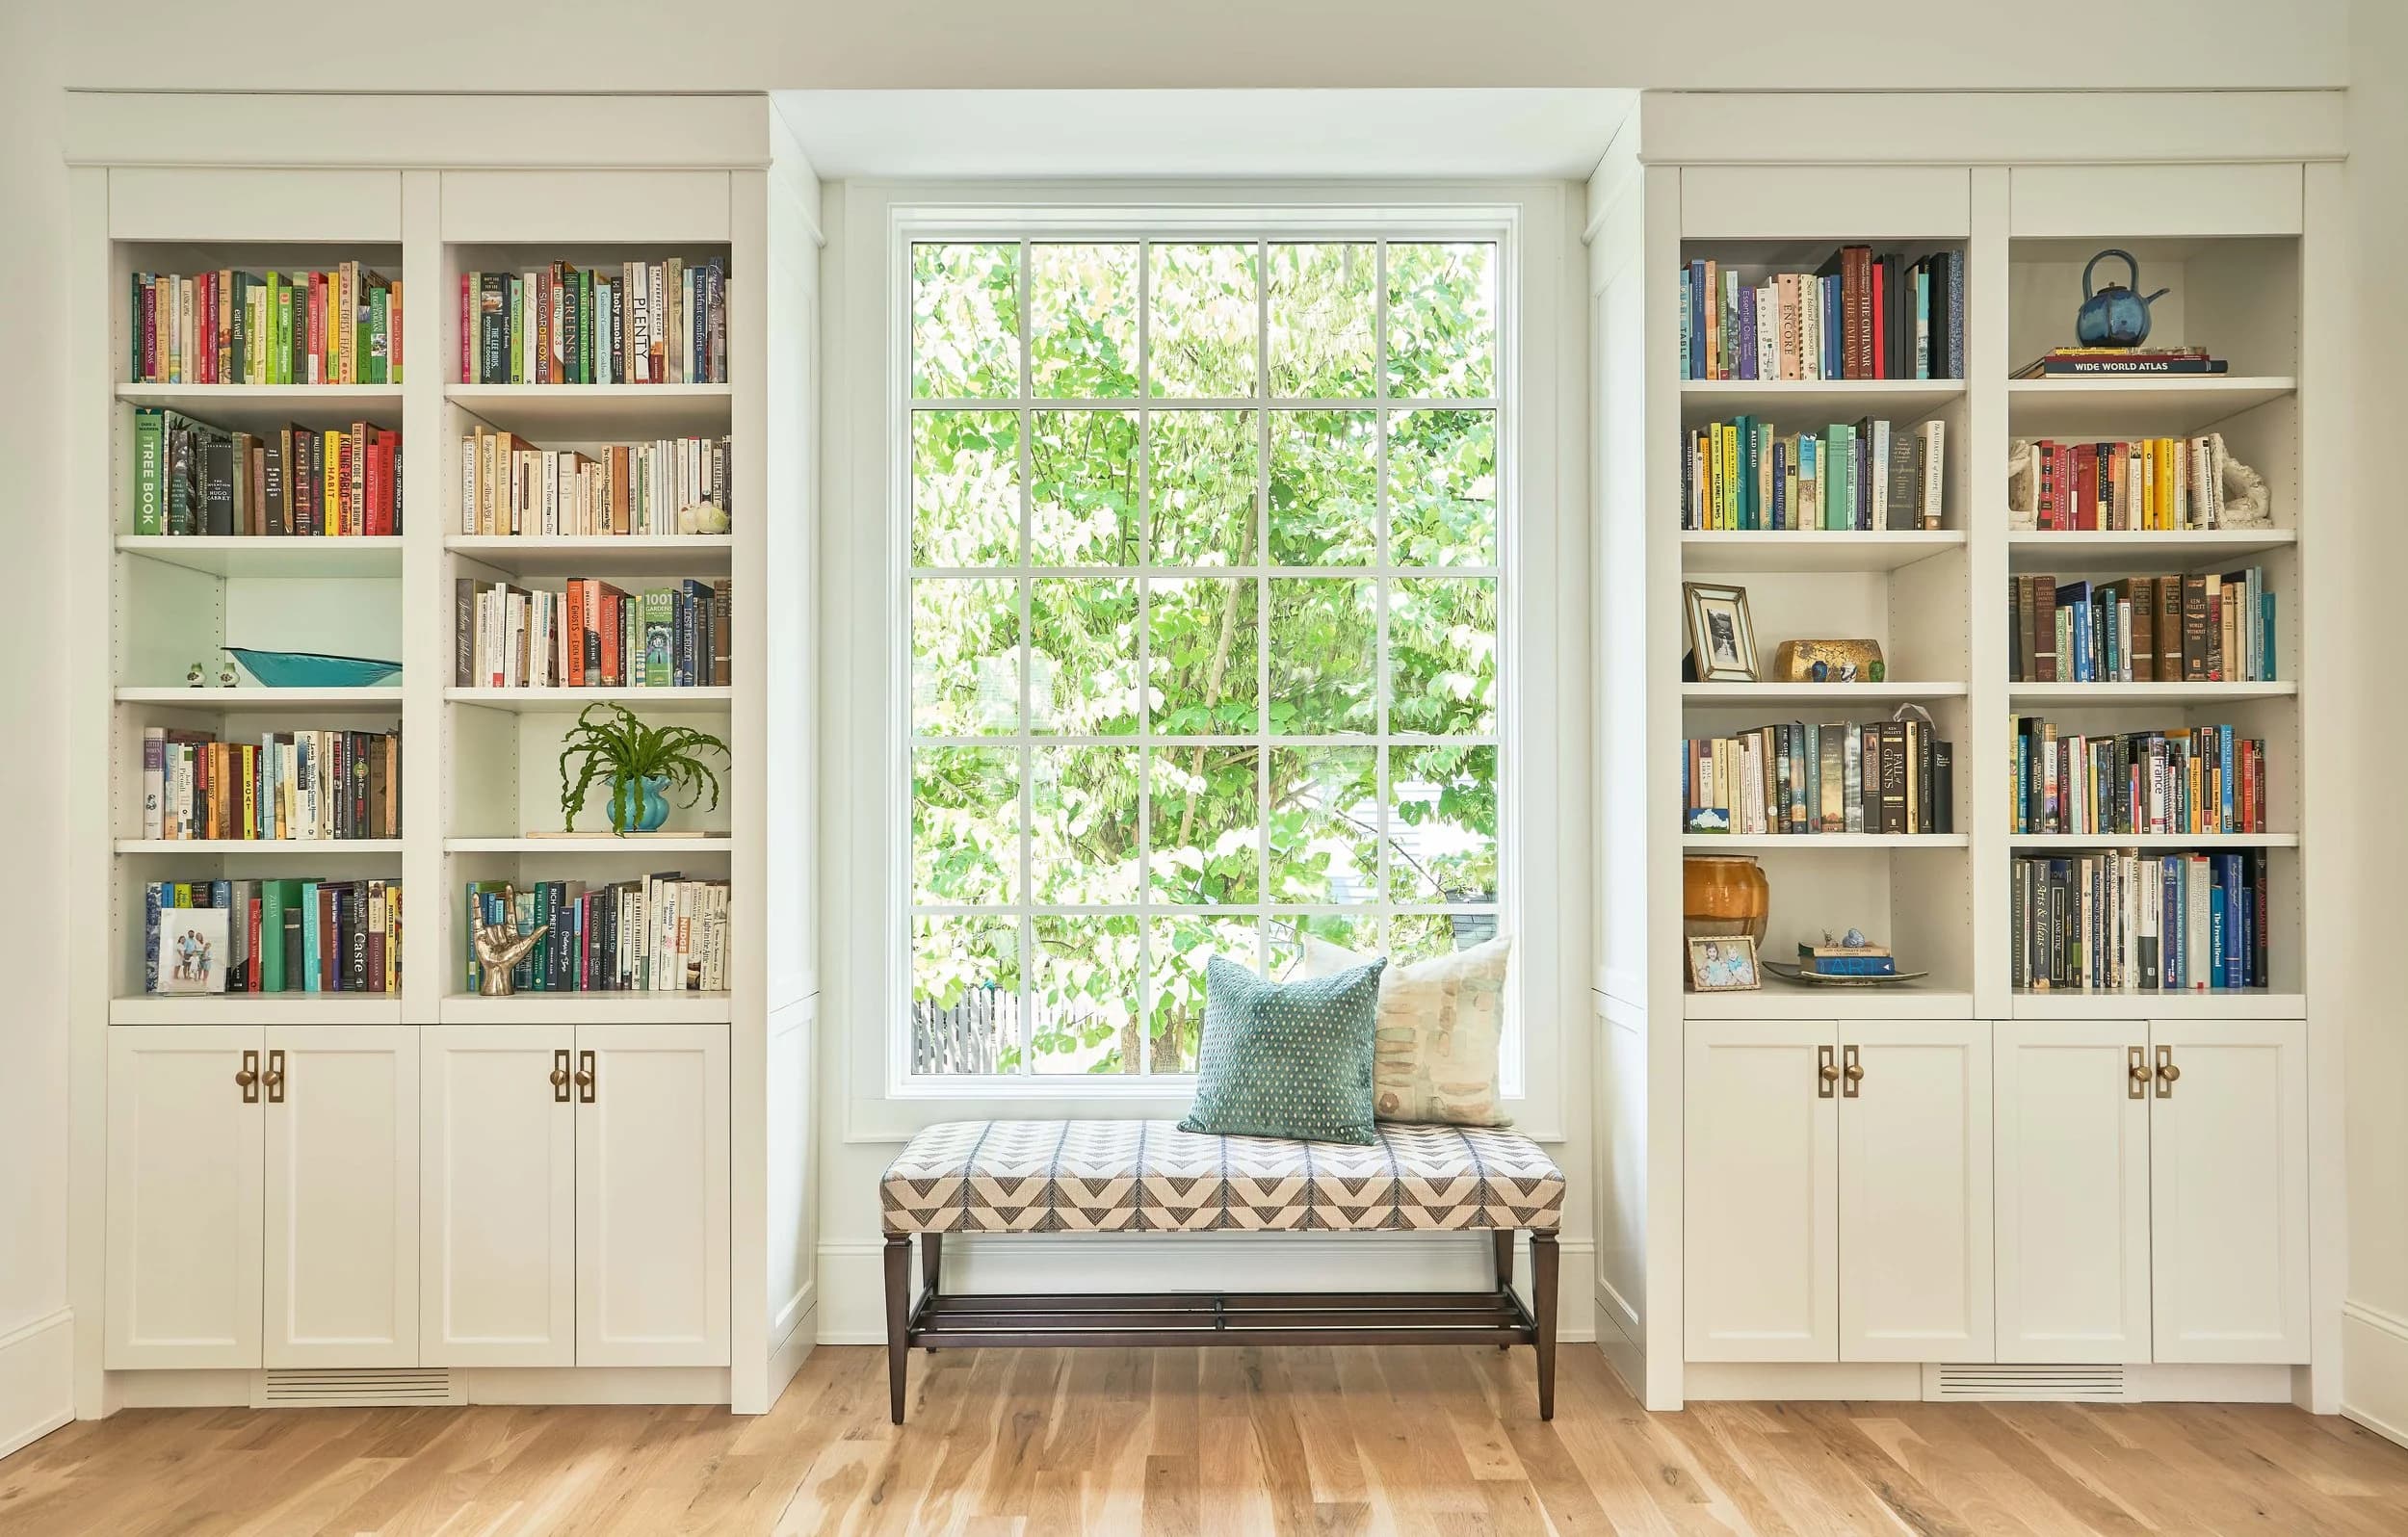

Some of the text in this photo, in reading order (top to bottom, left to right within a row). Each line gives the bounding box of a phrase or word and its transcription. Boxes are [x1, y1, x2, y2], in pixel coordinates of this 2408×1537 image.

[234, 309, 243, 340] eat well
[565, 293, 576, 354] GREENS
[613, 292, 621, 350] holy smoke
[634, 298, 647, 360] PLENTY
[696, 275, 705, 352] breakfast comforts
[1743, 290, 1751, 341] Essential Oils
[1783, 304, 1793, 356] ENCORE
[1806, 280, 1816, 357] Sea Island Seasons
[1847, 297, 1856, 368] THE CIVIL WAR
[1861, 296, 1871, 367] THE CIVIL WAR
[340, 309, 349, 359] FOREST FEAST
[539, 292, 547, 376] SUGARDETOXME
[580, 331, 587, 341] IN
[2075, 362, 2169, 372] WIDE WORLD ATLAS
[340, 437, 350, 469] KILLING
[714, 456, 723, 486] WALKABLE
[143, 442, 154, 525] TREE BOOK
[340, 471, 350, 498] PABLO
[353, 425, 362, 527] THE DA VINCI CODE DAN BROWN
[572, 605, 580, 632] GHOSTS
[646, 594, 673, 605] 1001
[572, 640, 580, 656] EDEN
[684, 607, 693, 662] LOST HORIZON
[572, 657, 580, 673] PARK
[1883, 748, 1893, 789] GIANTS
[1893, 753, 1903, 777] FALL
[2154, 757, 2165, 794] France
[703, 917, 712, 933] Light
[2037, 883, 2047, 946] Arts & Ideas
[354, 932, 366, 972] Caste
[679, 918, 688, 952] NUDGE
[703, 939, 712, 949] the
[703, 949, 712, 964] Attic
